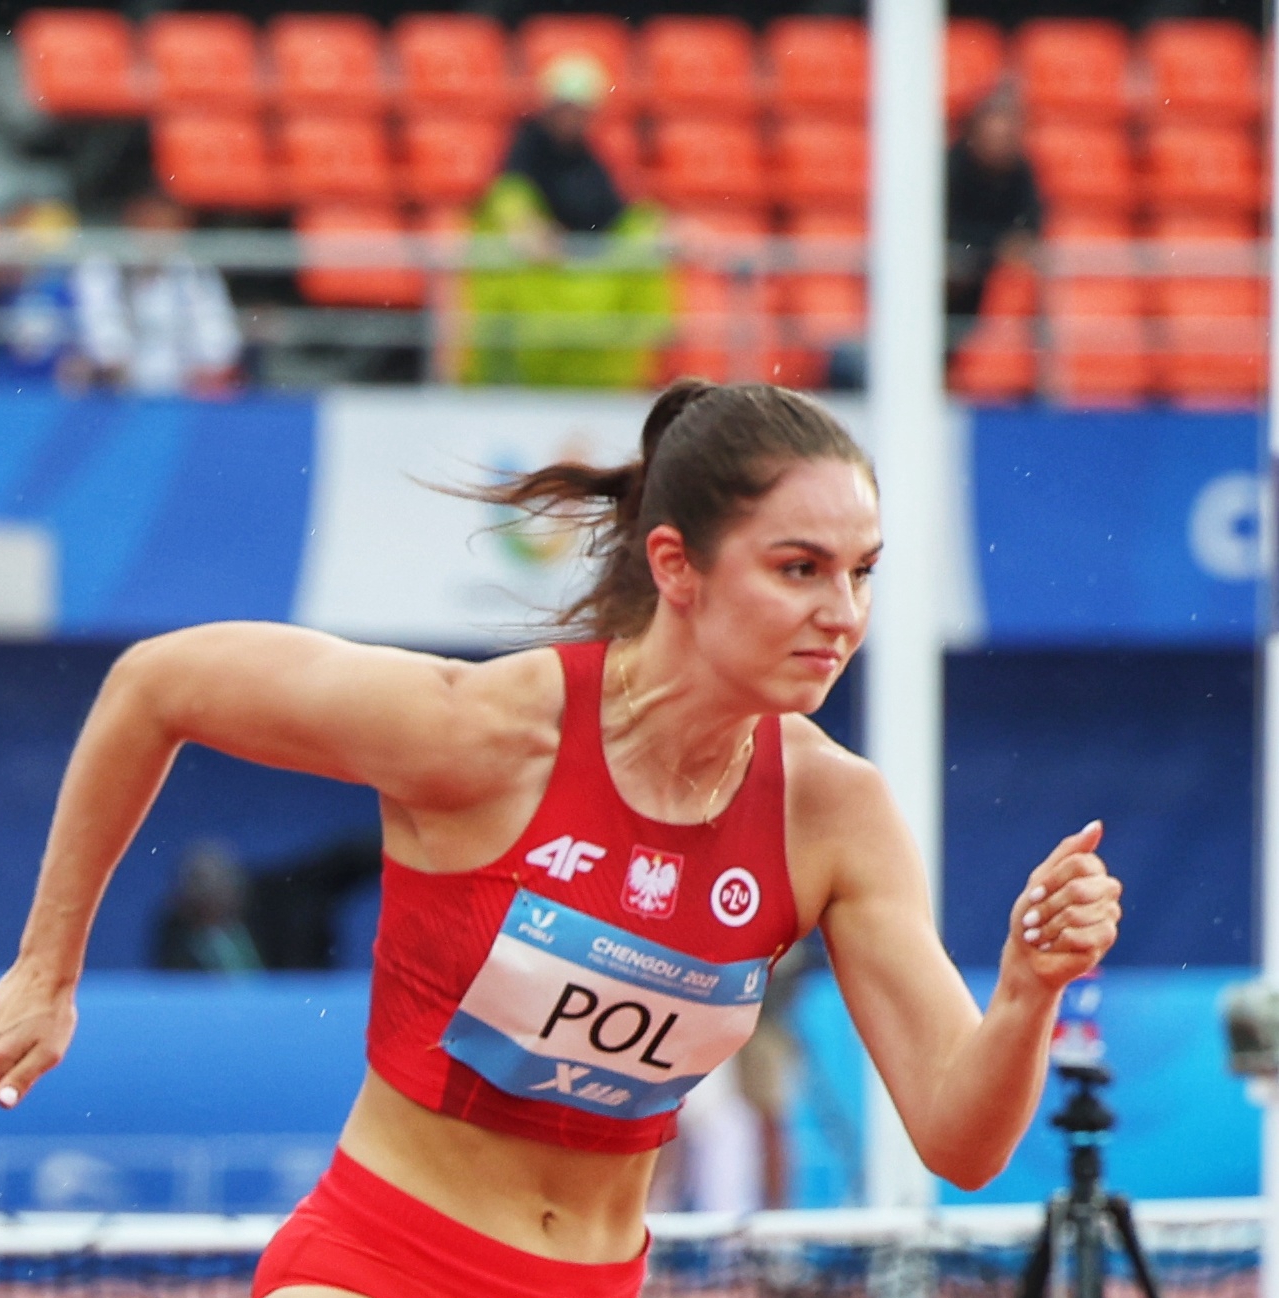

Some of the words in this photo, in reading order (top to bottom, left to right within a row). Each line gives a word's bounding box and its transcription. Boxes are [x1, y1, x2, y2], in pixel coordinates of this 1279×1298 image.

[526, 834, 607, 883] 4F
[592, 936, 683, 978] CHENGDU
[539, 983, 675, 1070] POL
